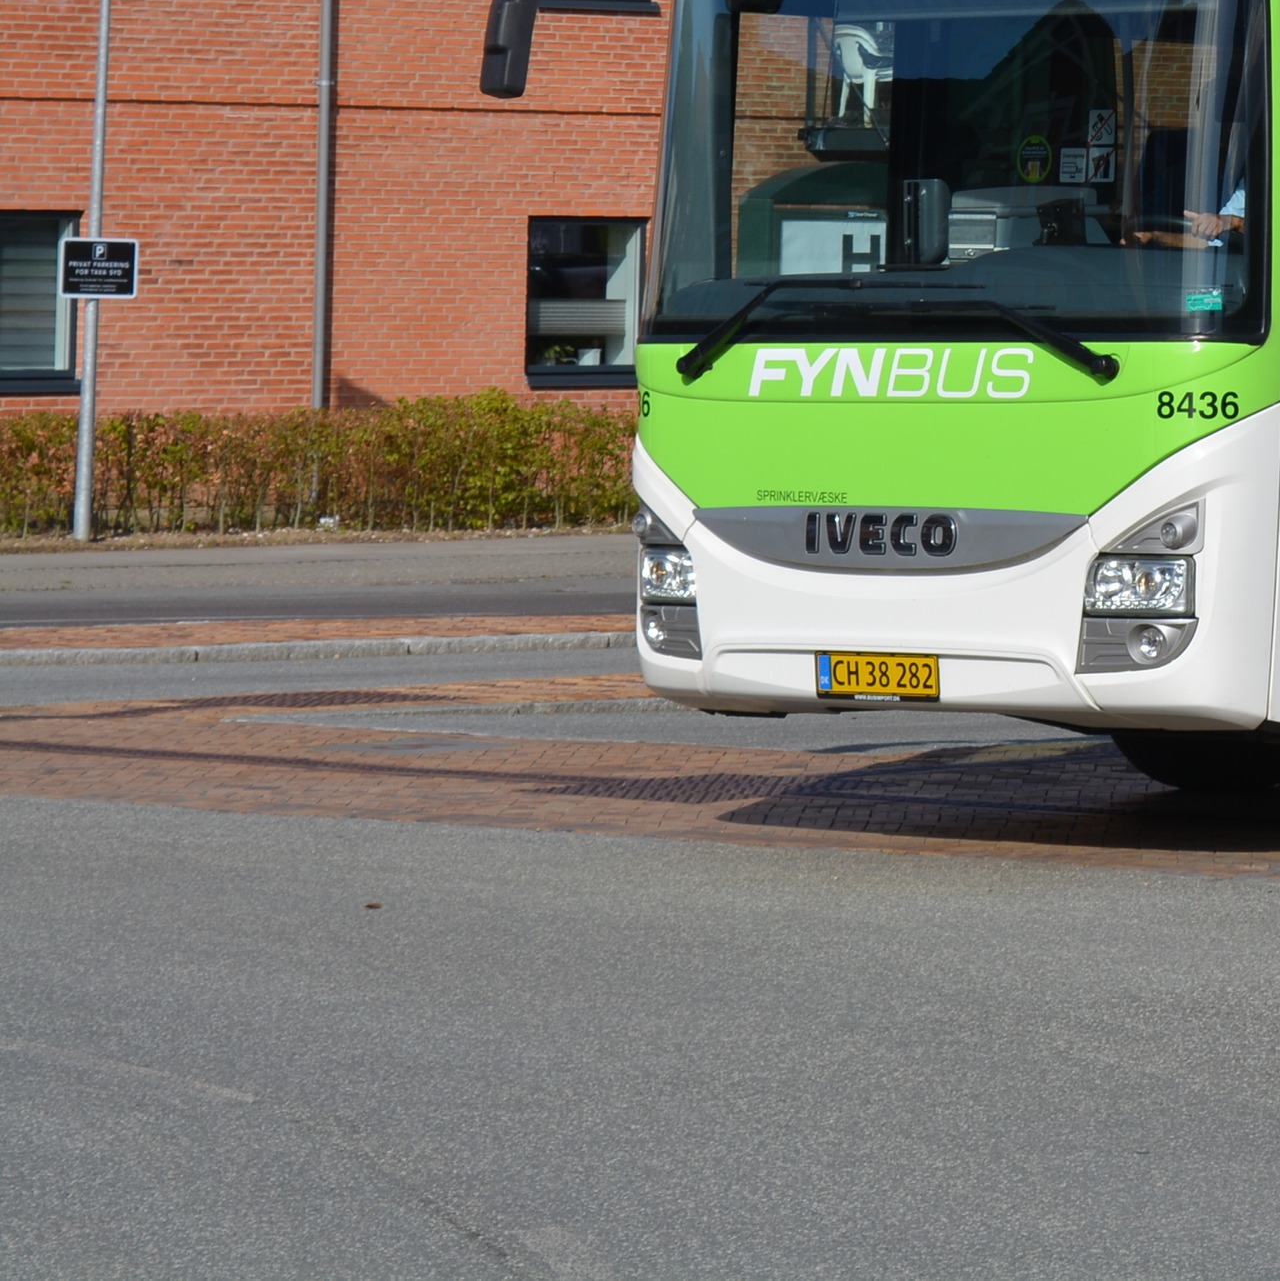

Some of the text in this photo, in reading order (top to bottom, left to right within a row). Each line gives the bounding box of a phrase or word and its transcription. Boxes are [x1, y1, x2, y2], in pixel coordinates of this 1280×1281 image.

[93, 261, 129, 269] PARKERING
[96, 246, 104, 258] P
[748, 348, 1034, 398] FYNBUS
[1156, 391, 1240, 420] 8436
[756, 489, 848, 504] SPRINKLERVÆSKE
[805, 511, 958, 557] IVECO
[832, 660, 933, 689] CH 38 282
